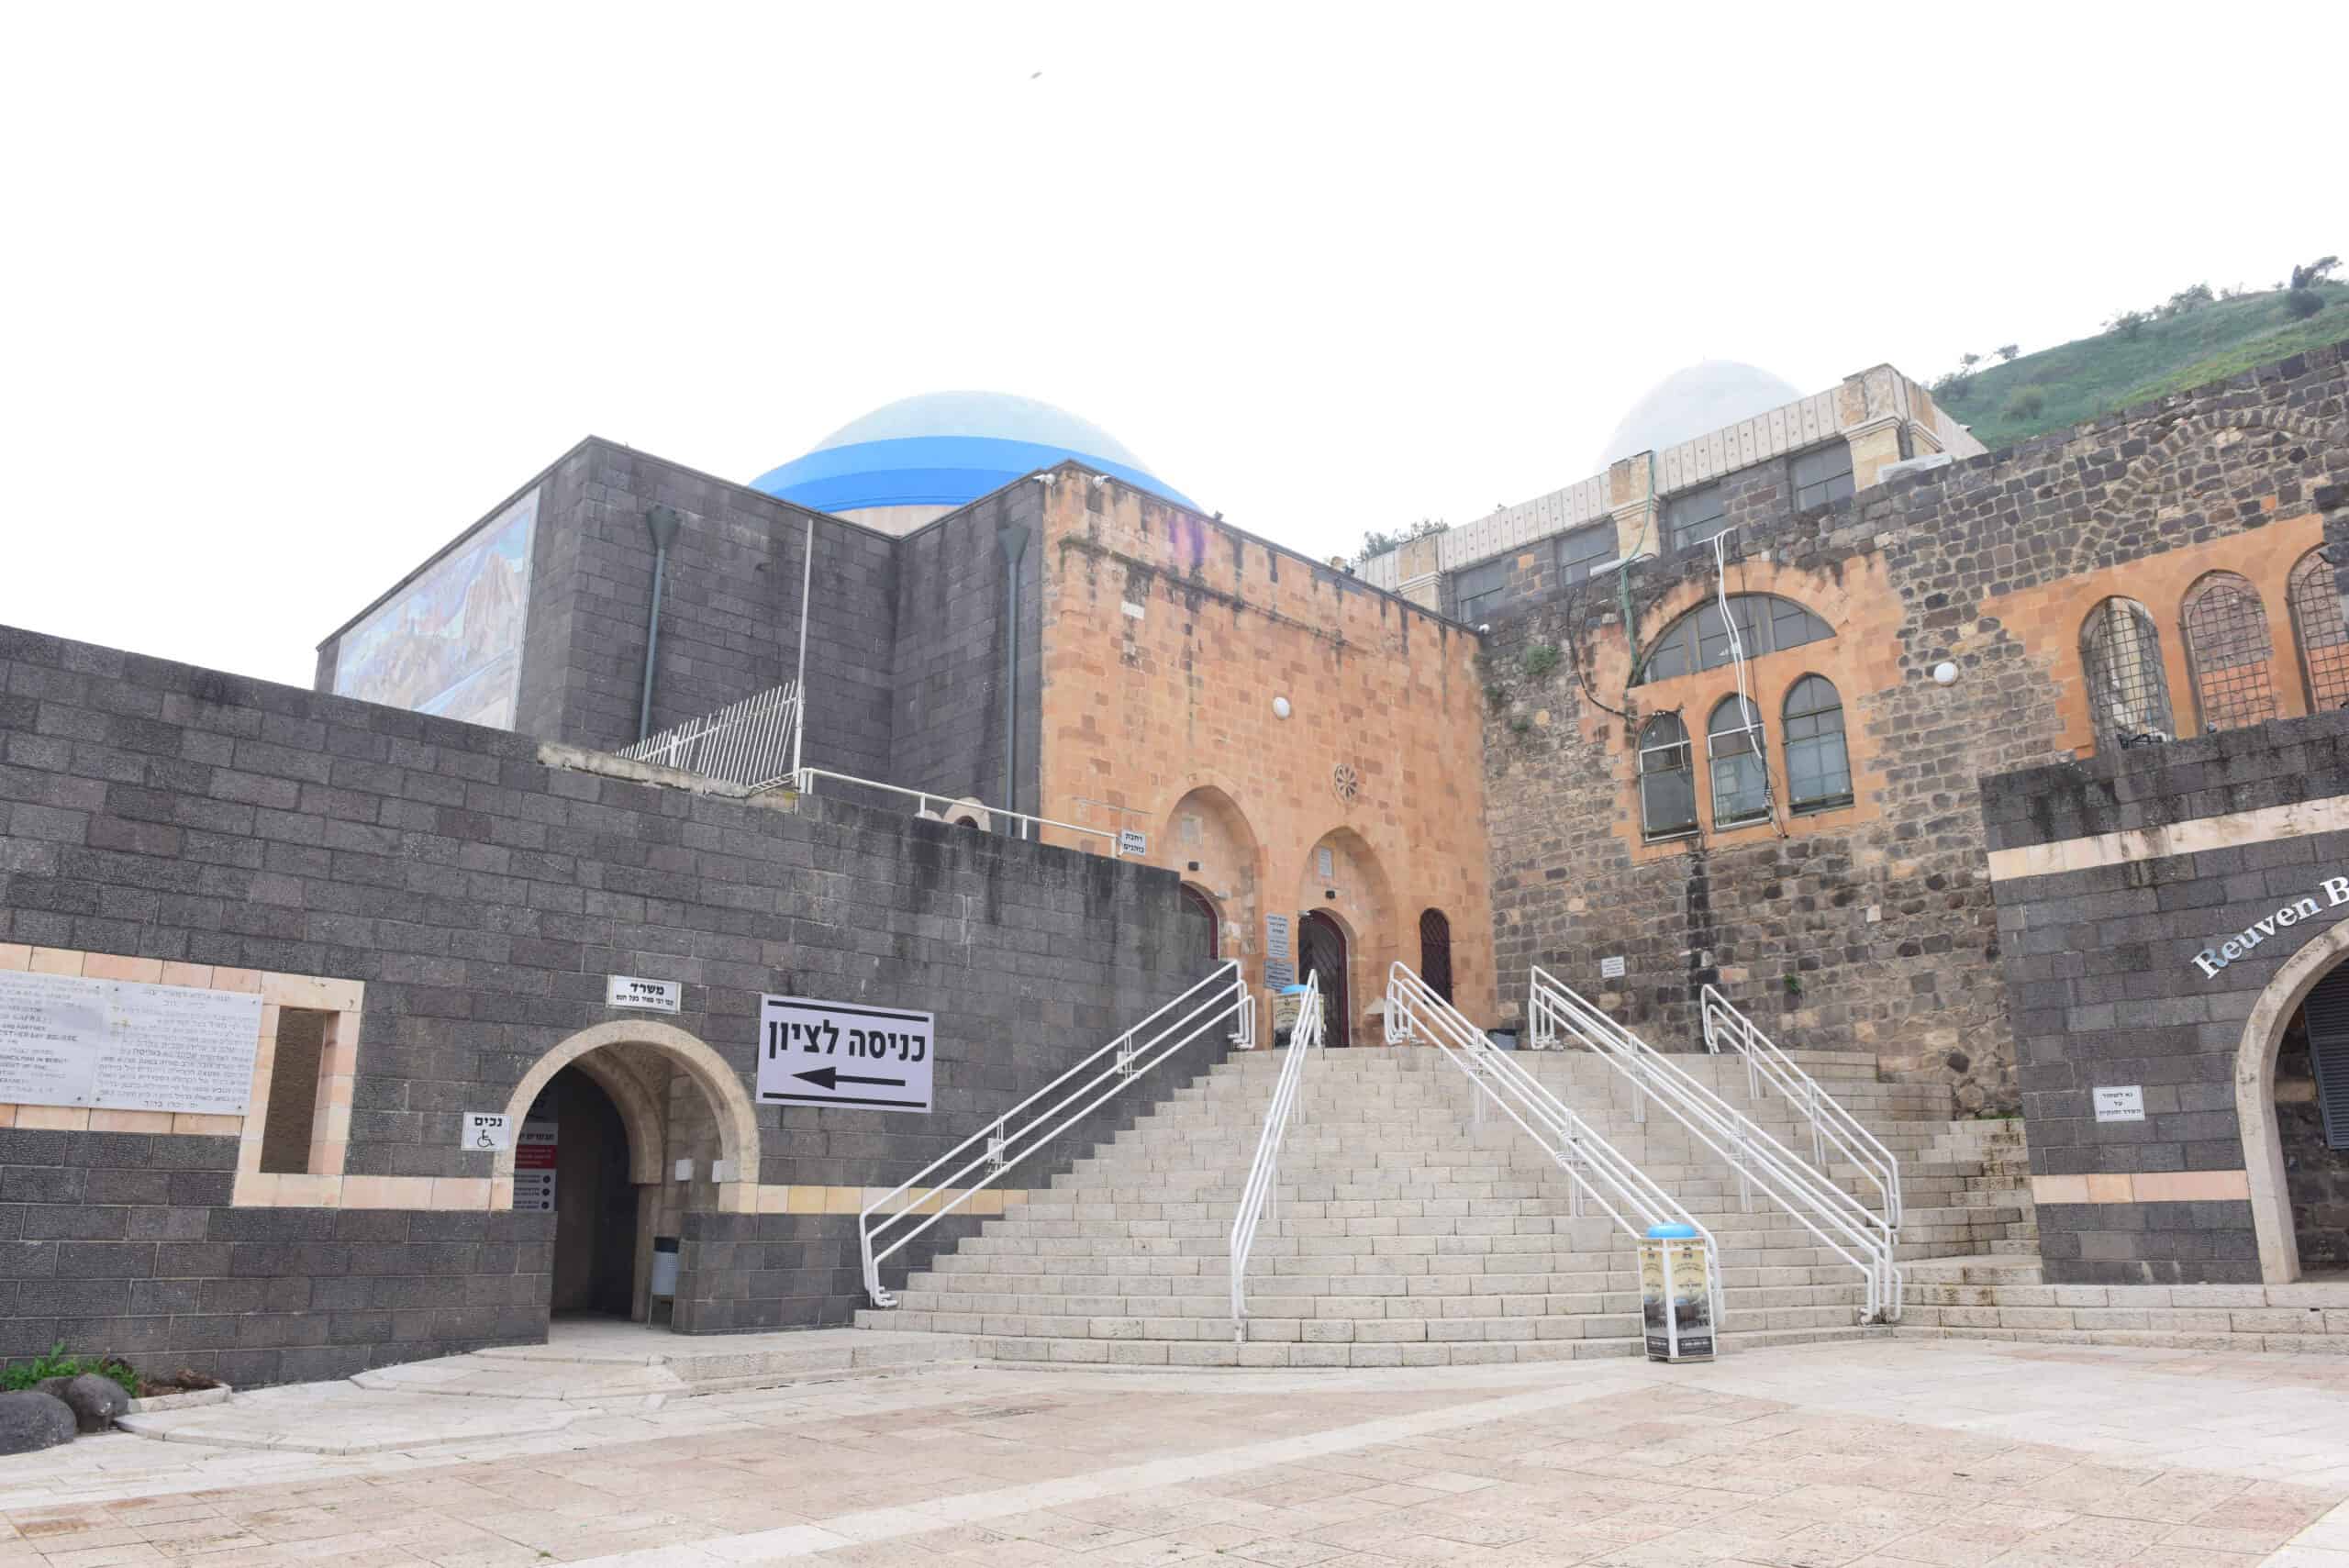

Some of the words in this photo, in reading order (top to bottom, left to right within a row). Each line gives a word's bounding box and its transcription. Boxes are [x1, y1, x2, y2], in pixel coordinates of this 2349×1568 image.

[2190, 897, 2323, 980] Reuven
[629, 982, 664, 995] משרד
[769, 1018, 840, 1060] לציון
[849, 1029, 926, 1062] כניסה
[474, 1117, 503, 1128] נכים
